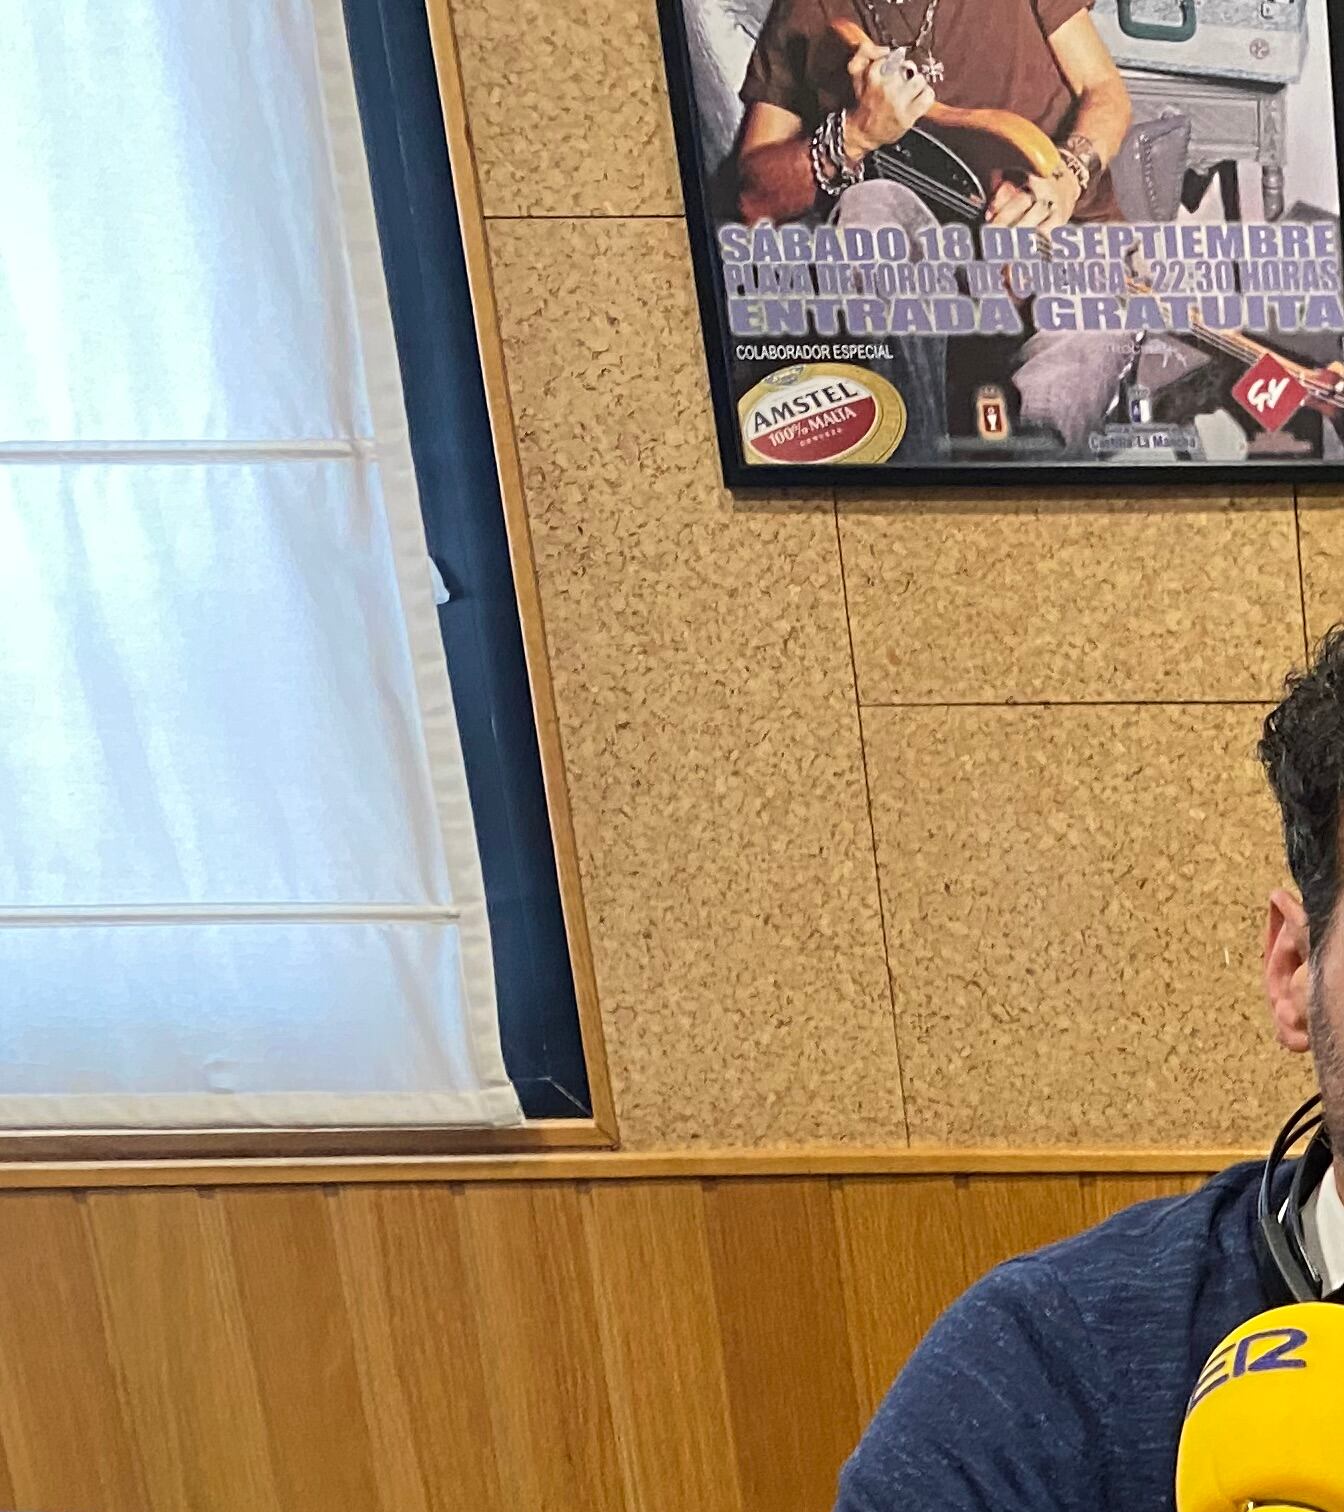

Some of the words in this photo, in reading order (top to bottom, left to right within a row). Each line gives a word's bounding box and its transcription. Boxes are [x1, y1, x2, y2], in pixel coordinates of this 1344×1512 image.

[719, 222, 908, 263] SÁBADO
[913, 226, 973, 262] 18
[981, 226, 1038, 262] DE
[1050, 224, 1336, 261] SEPTIEMBRE
[723, 263, 812, 297] PLAZA
[817, 263, 852, 297] DE
[858, 262, 958, 298] TOROS
[966, 261, 1004, 298] DE
[1009, 260, 1127, 298] CUENCA
[1149, 260, 1233, 293] 22:30
[1240, 259, 1339, 293] HORAS
[729, 297, 1023, 334] ENTRADA
[735, 344, 832, 361] COLABORADOR
[833, 344, 894, 360] ESPECIAL
[753, 382, 858, 433] AMSTEL
[768, 423, 809, 447] 100%
[808, 406, 857, 432] MALTA
